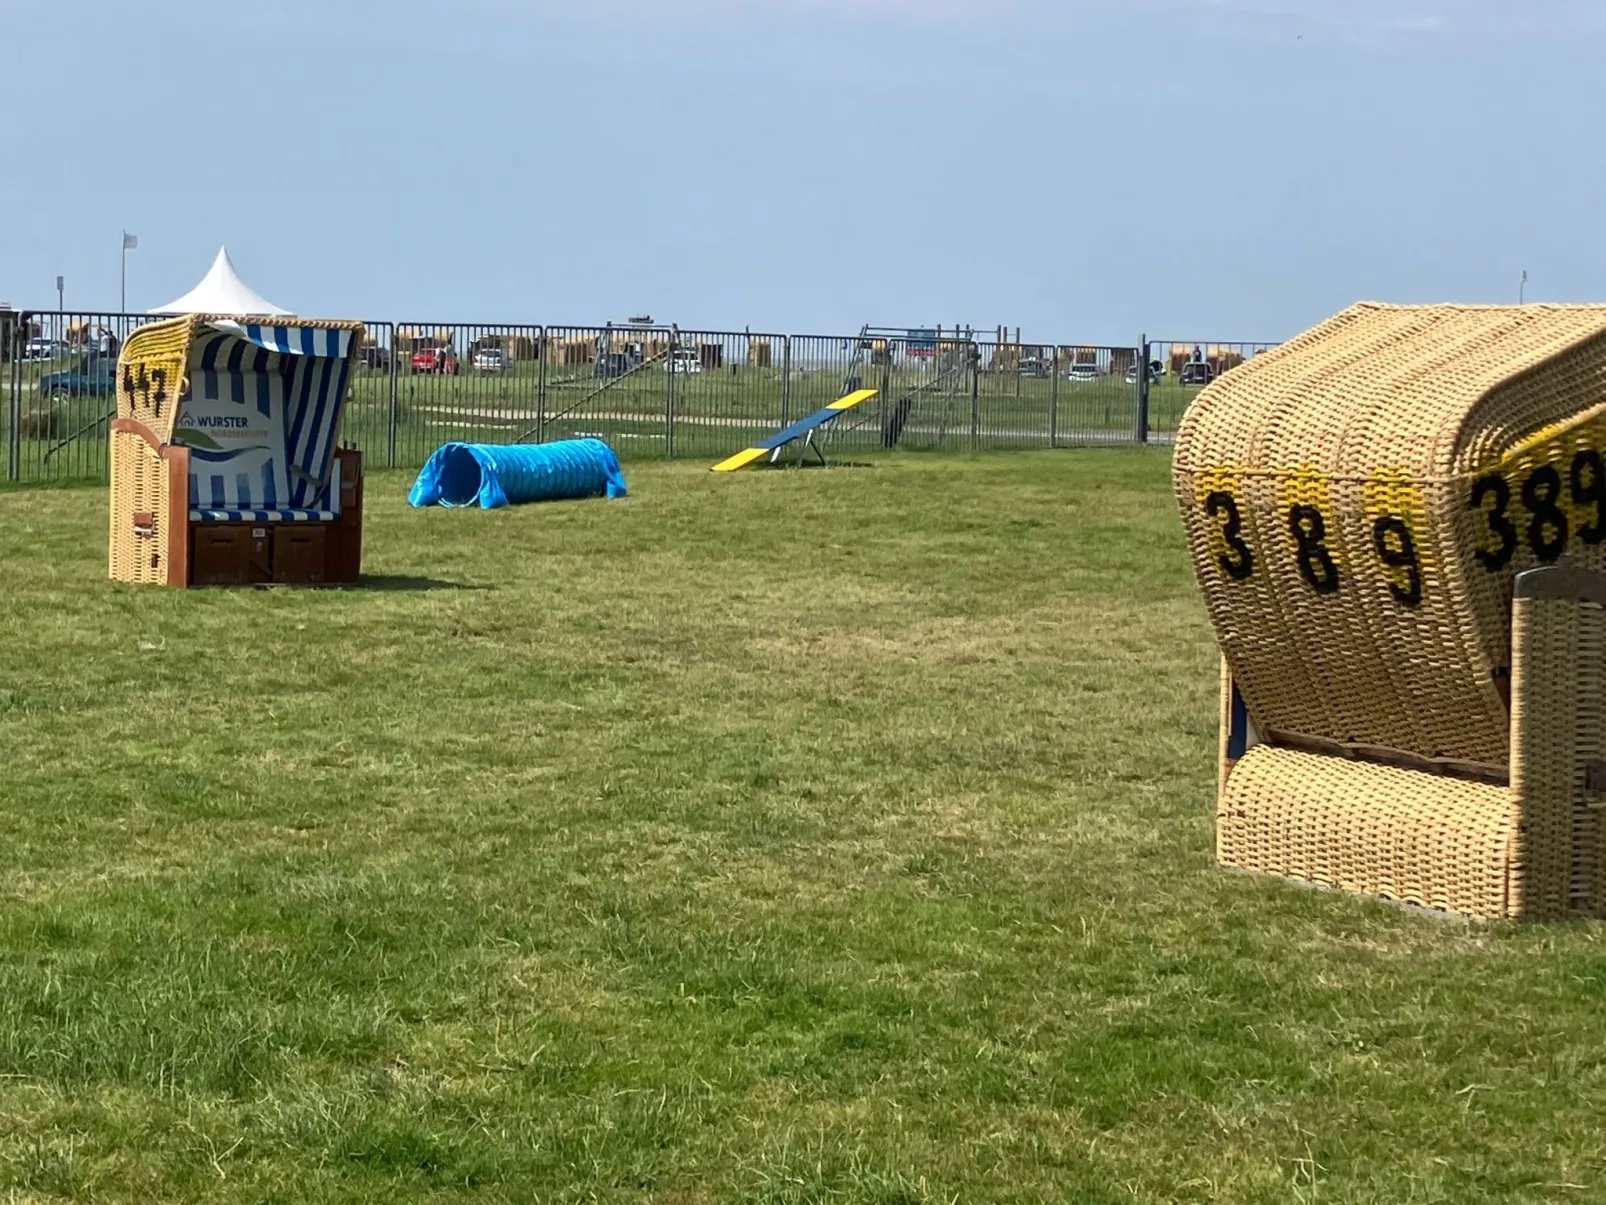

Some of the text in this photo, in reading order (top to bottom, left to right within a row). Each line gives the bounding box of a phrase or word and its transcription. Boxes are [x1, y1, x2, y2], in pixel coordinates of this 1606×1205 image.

[197, 416, 248, 428] WURSTER
[1206, 490, 1422, 605] 389
[1471, 450, 1606, 573] 389
